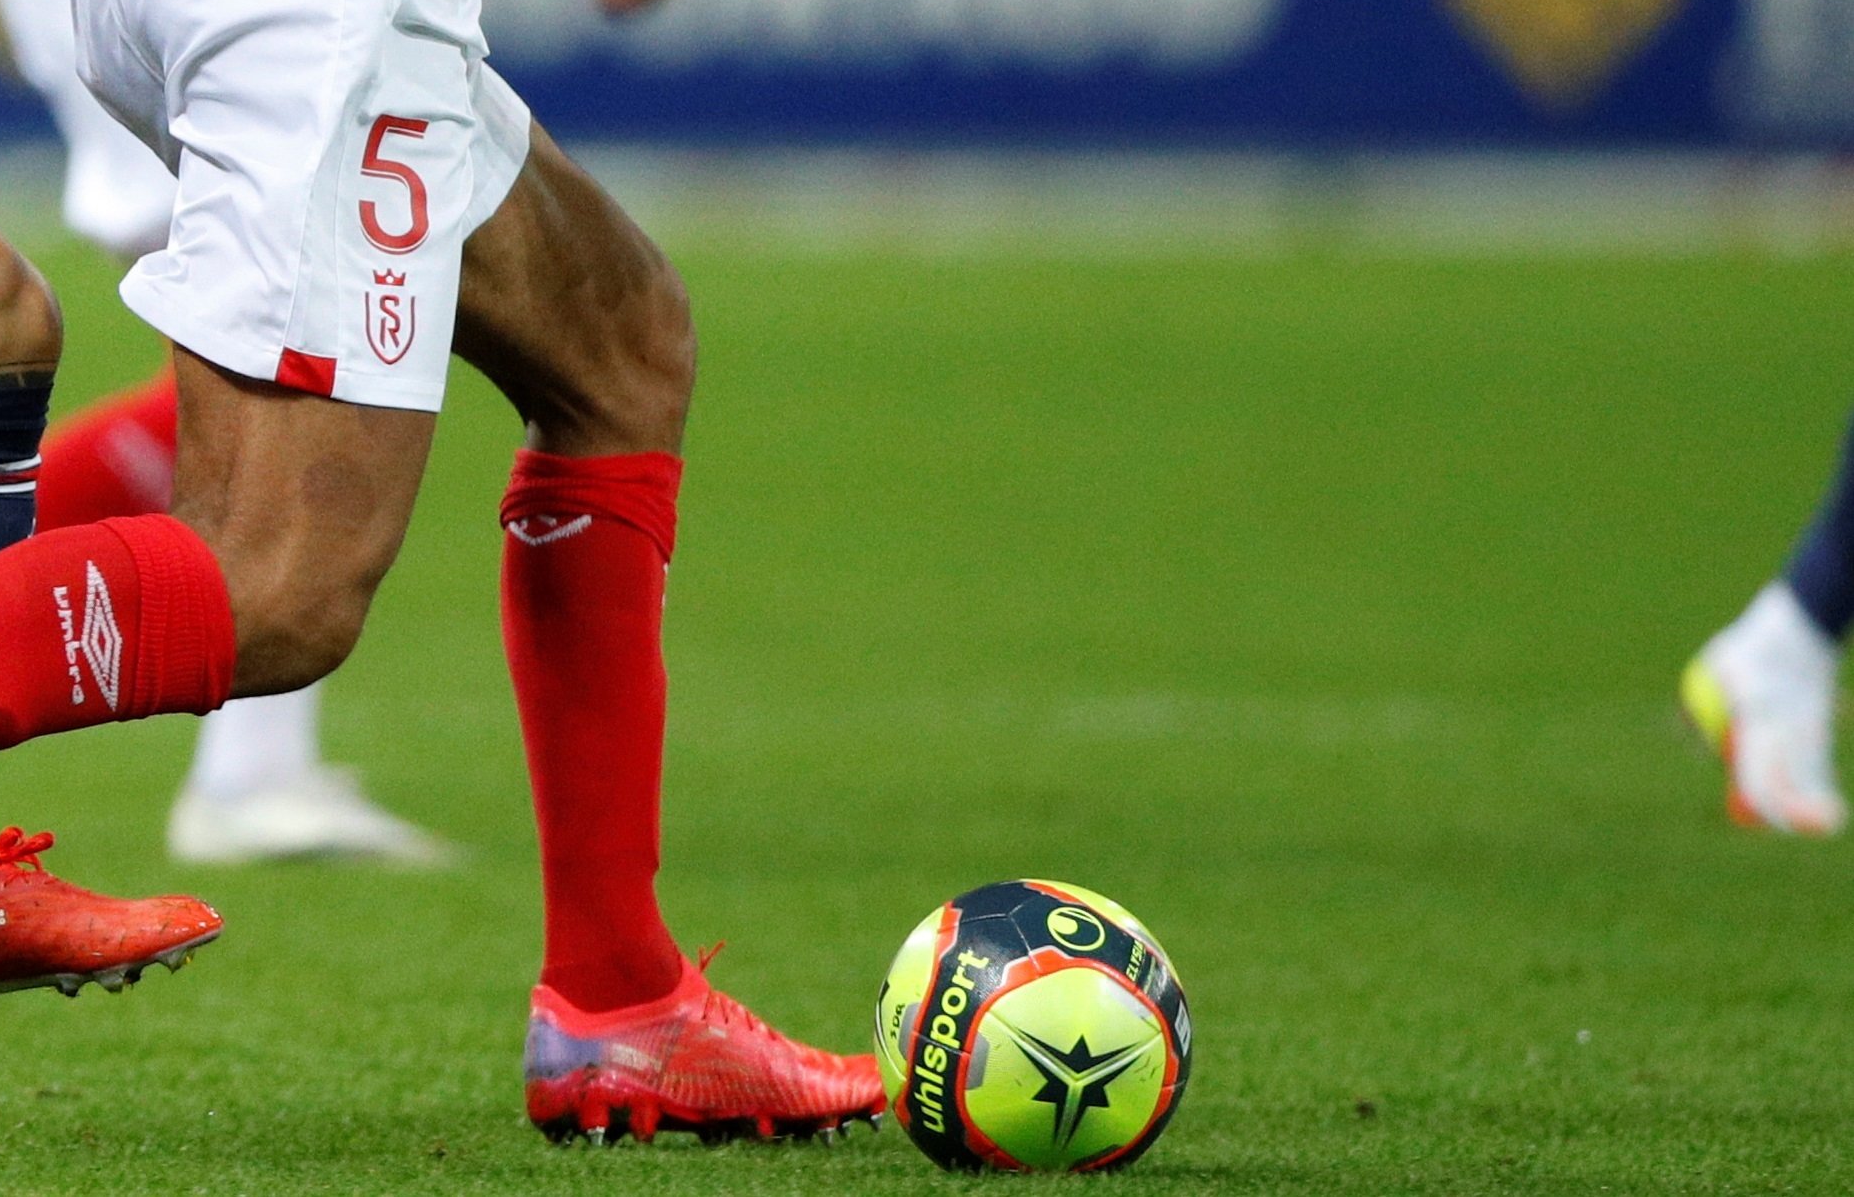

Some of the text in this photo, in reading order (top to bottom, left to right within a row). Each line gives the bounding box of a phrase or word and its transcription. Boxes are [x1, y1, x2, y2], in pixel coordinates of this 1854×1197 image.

[357, 113, 431, 256] 5
[53, 585, 86, 705] umbro
[913, 948, 990, 1135] uhlsport
